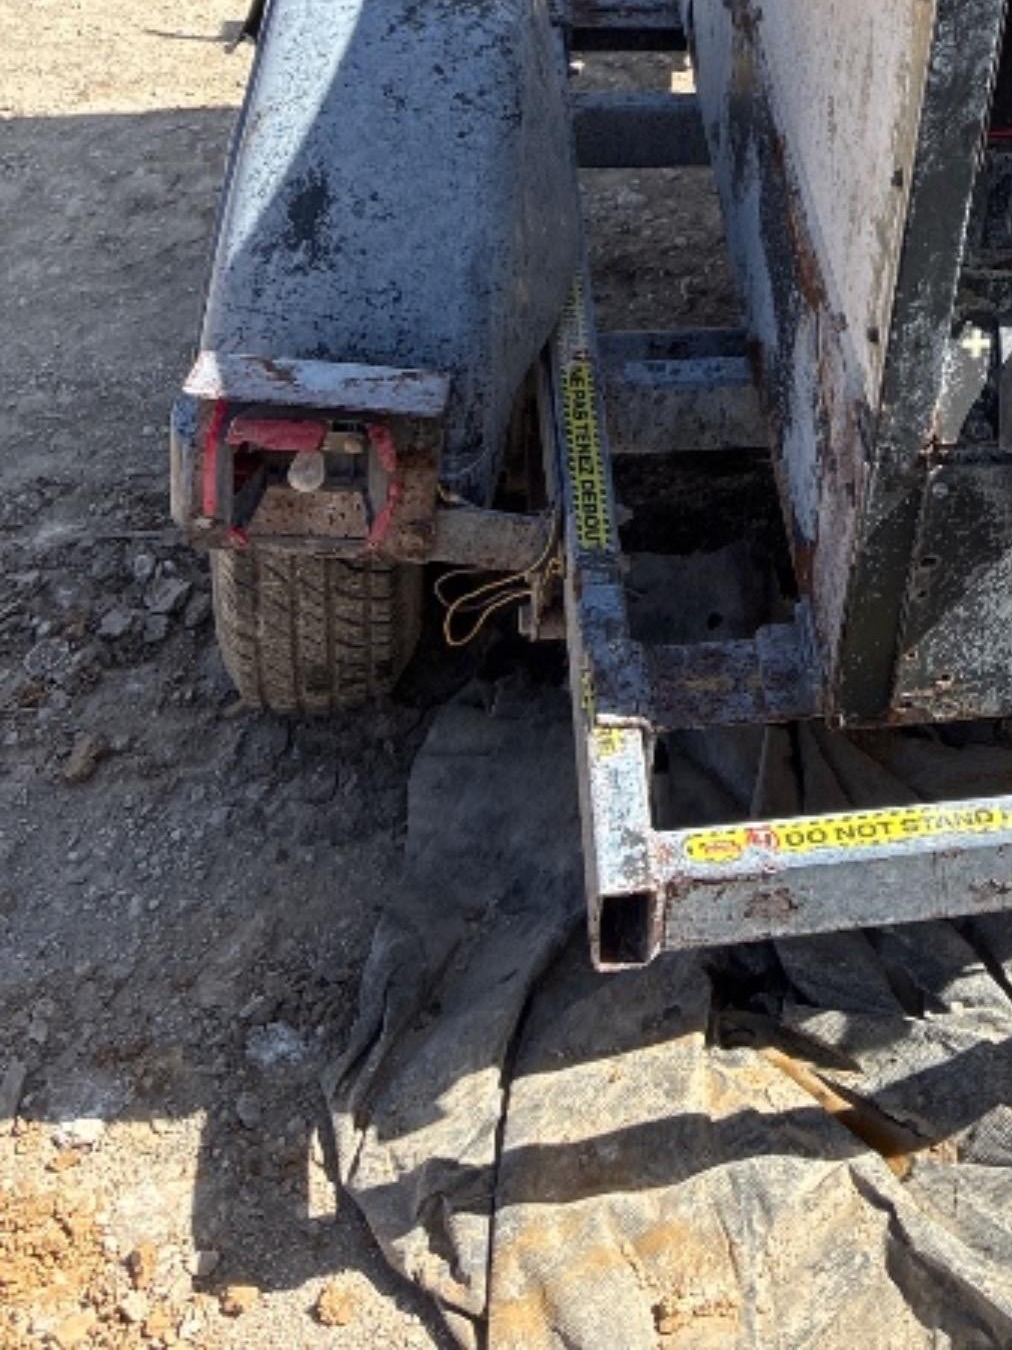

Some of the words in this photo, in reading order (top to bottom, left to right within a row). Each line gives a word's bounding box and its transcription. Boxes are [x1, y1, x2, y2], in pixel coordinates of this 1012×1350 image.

[784, 827, 828, 848] DO
[834, 821, 891, 842] NOT
[899, 808, 995, 834] STAND
